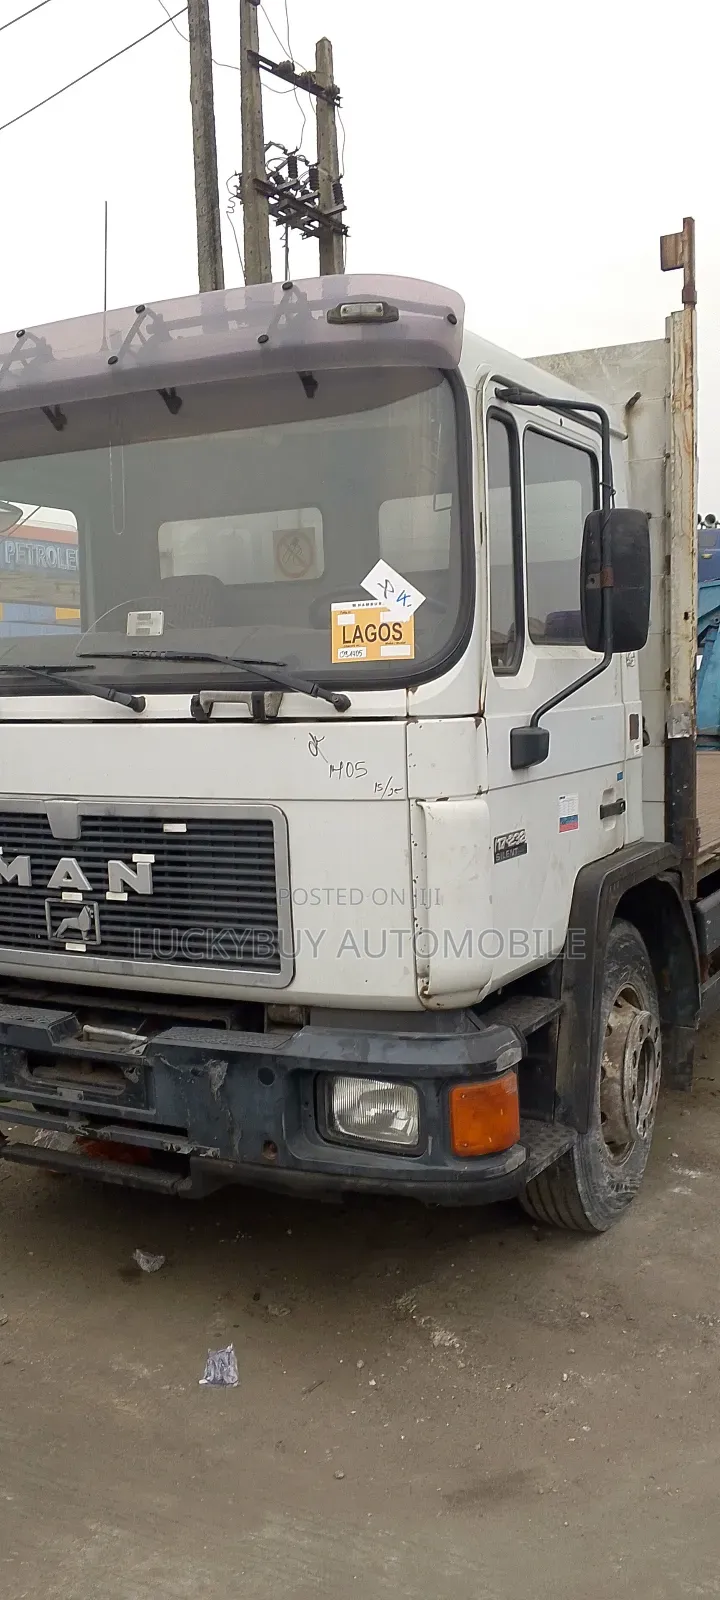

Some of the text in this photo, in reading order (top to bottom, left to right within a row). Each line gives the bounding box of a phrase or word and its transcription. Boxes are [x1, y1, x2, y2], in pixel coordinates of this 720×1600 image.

[5, 540, 78, 571] PETROLE
[343, 622, 403, 644] LAGOS
[0, 855, 154, 894] MAN
